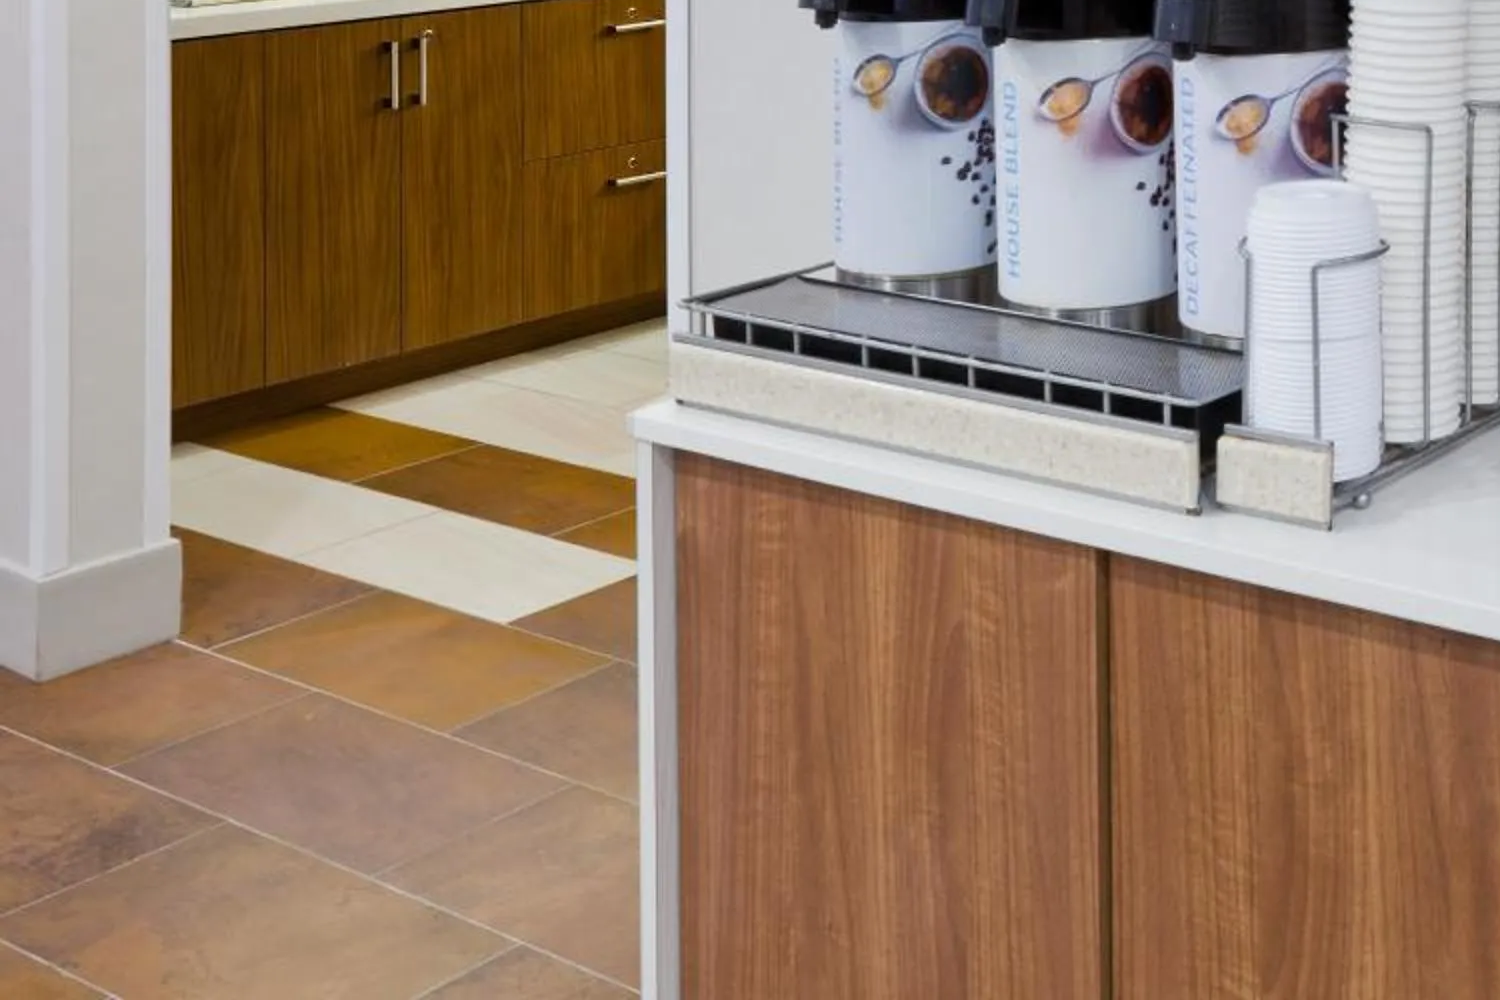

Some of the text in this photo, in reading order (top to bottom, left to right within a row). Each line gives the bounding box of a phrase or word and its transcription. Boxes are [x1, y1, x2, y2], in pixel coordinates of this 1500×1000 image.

[1003, 81, 1021, 278] HOUSE BLEND
[1180, 77, 1200, 315] DECAFFEINATED
